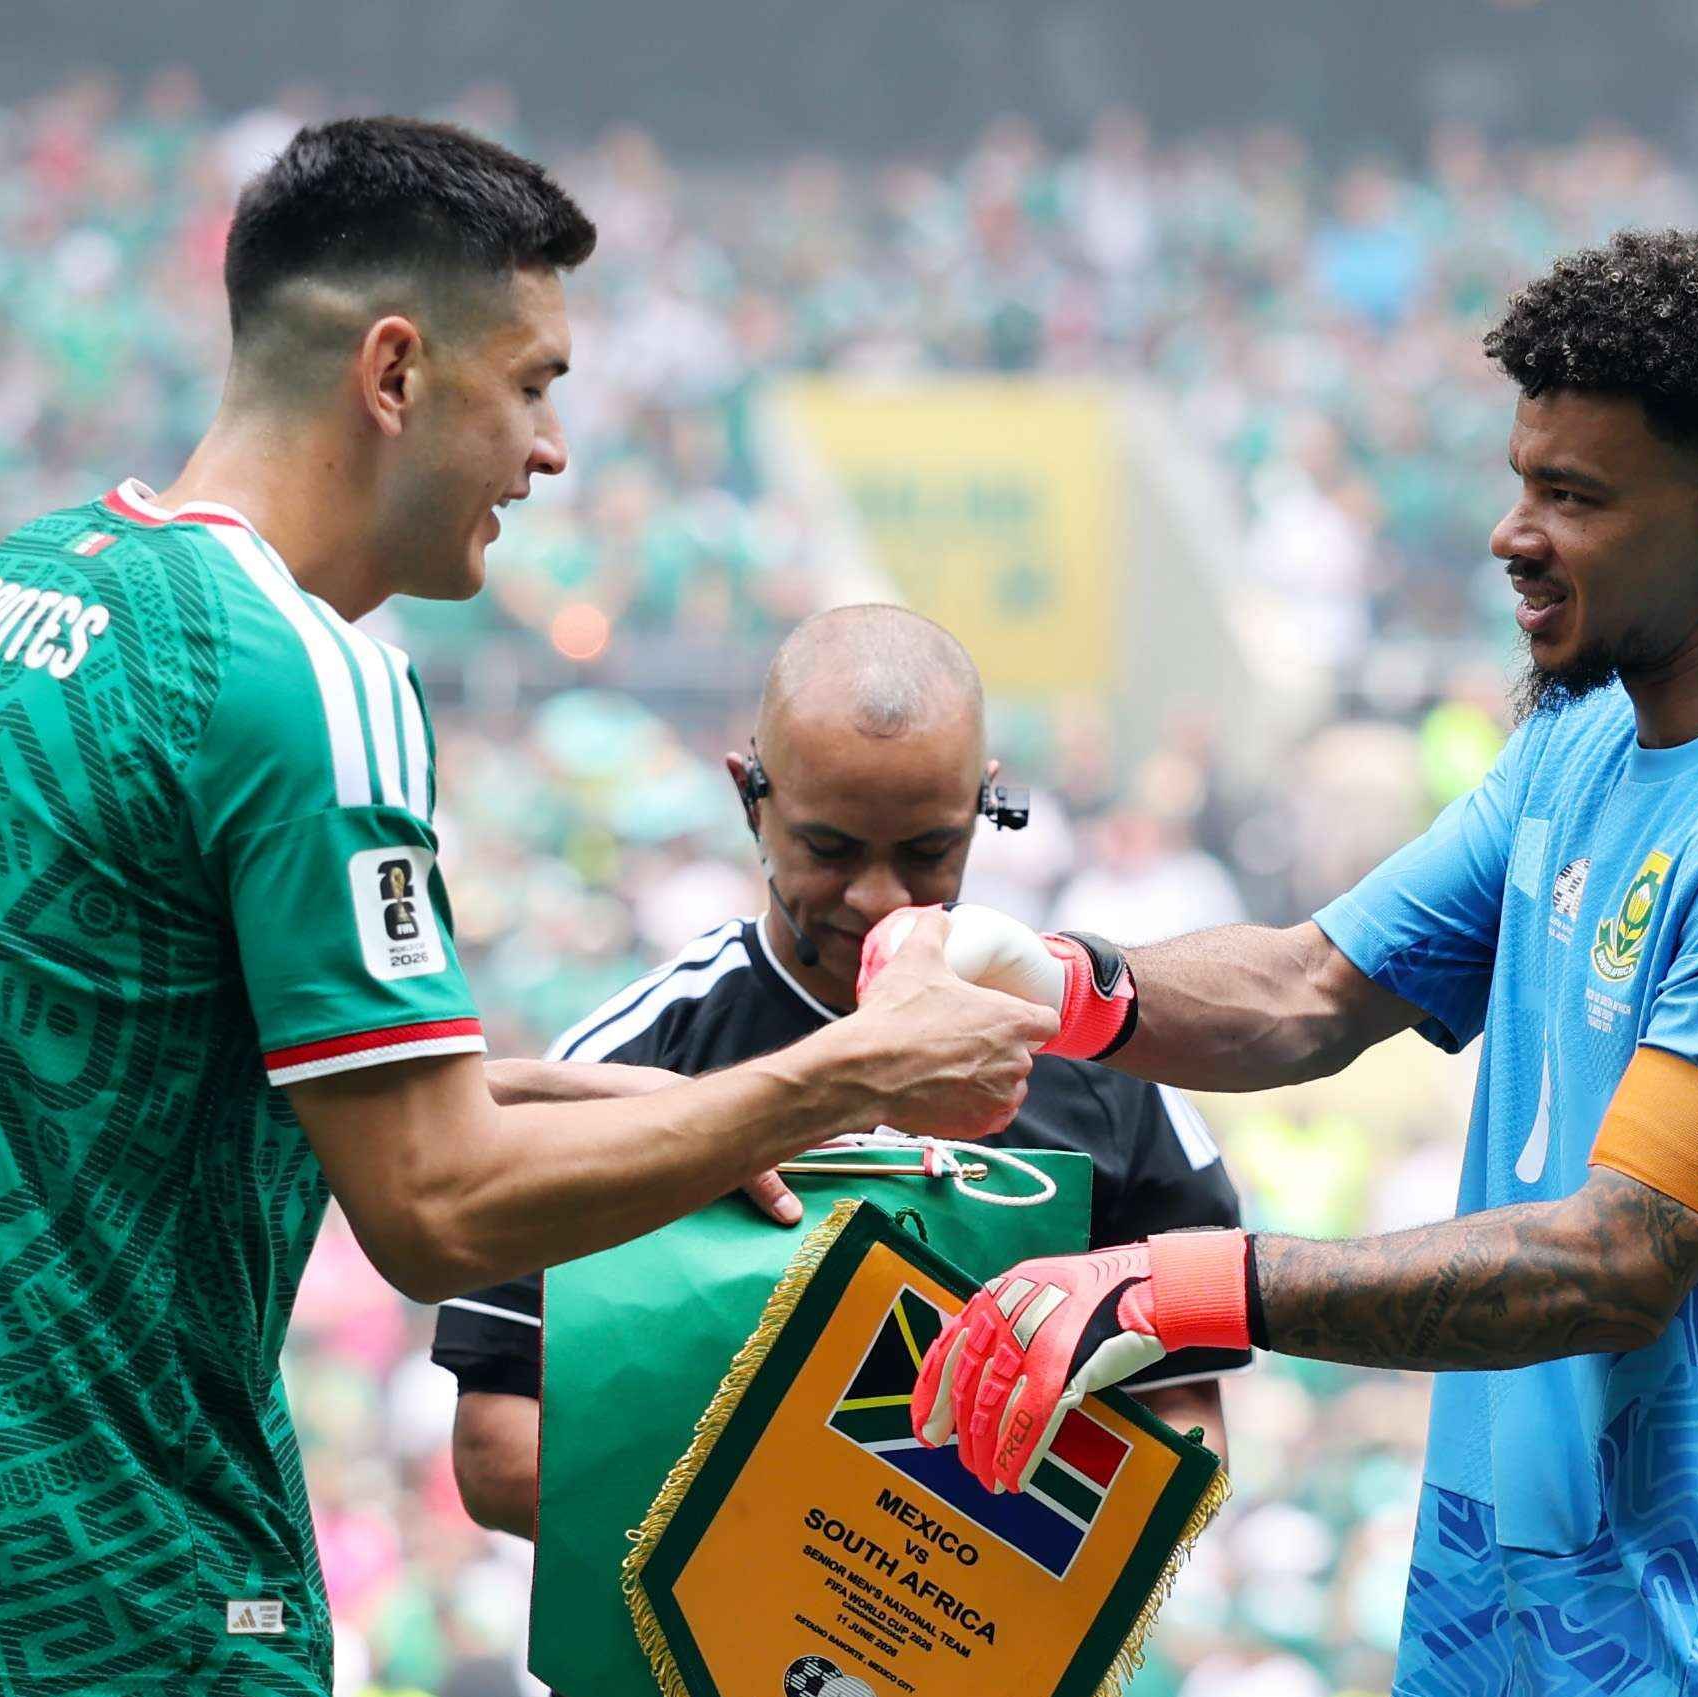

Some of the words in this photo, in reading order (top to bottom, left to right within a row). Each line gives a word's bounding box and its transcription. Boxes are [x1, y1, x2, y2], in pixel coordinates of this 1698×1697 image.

[390, 952, 429, 967] 2026
[996, 1408, 1033, 1472] PRED
[876, 1488, 979, 1566] MEXICO
[904, 1539, 929, 1564] VS
[803, 1545, 846, 1577] SENIOR
[847, 1571, 882, 1600] MEN'S
[883, 1595, 936, 1637] NATIONAL
[940, 1631, 971, 1658] TEAM
[804, 1508, 899, 1577] SOUTH
[897, 1571, 995, 1645] AFRICA
[824, 1578, 847, 1598] FIFA
[848, 1592, 886, 1620] WORLD
[887, 1618, 909, 1635] CUP
[795, 1613, 828, 1638] ESTADIO
[868, 1660, 897, 1682] MEXICO
[897, 1679, 915, 1694] CITY
[837, 1613, 848, 1625] 11
[848, 1622, 876, 1643] JUNE
[875, 1639, 898, 1657] 2026
